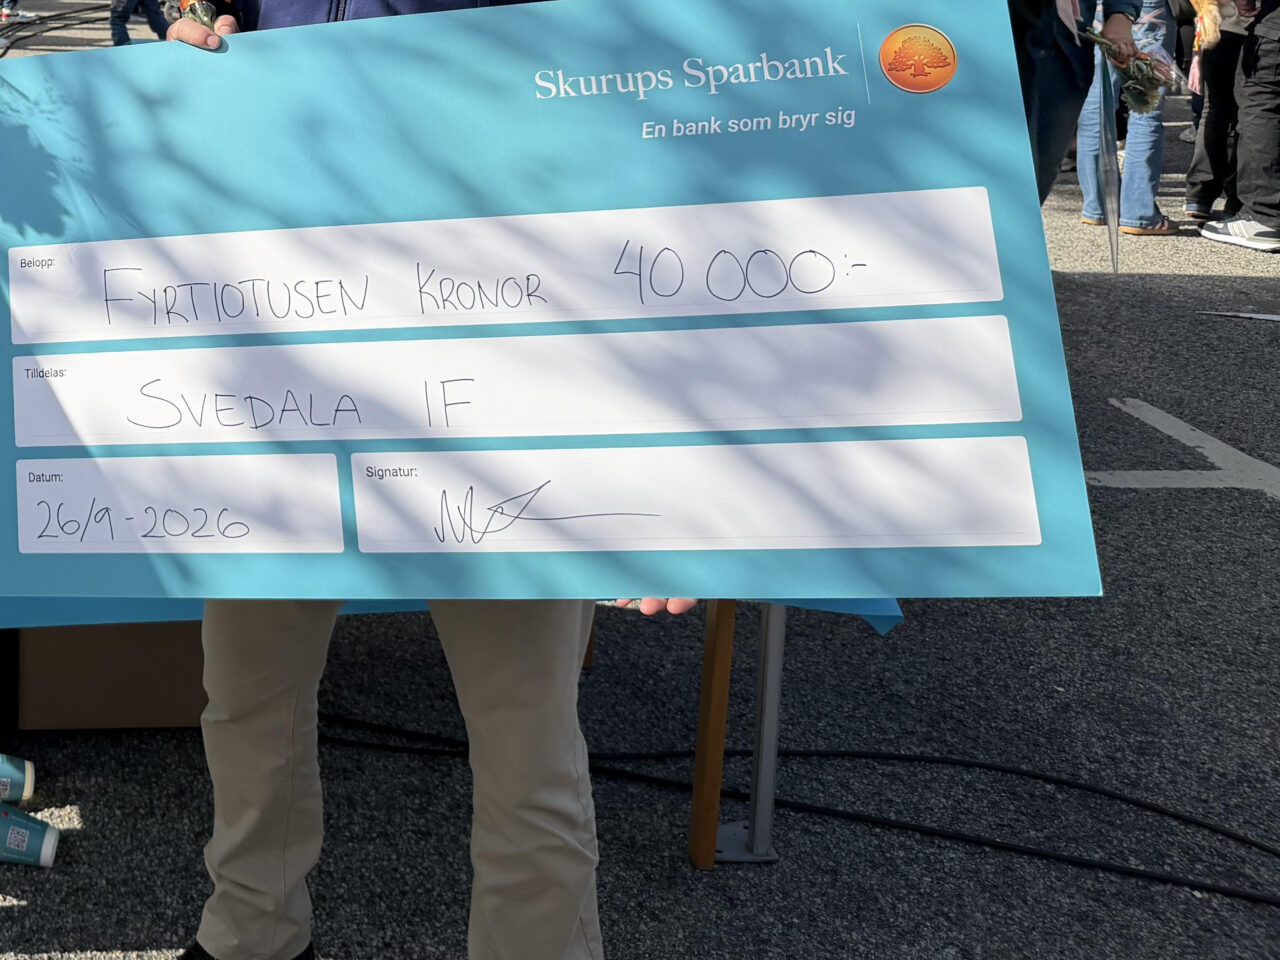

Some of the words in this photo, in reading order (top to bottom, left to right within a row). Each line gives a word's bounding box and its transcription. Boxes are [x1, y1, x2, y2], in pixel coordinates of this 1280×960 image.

[534, 67, 674, 101] Skurups
[681, 46, 848, 95] Sparbank
[641, 121, 666, 139] En
[672, 115, 722, 136] bank
[727, 116, 773, 133] som
[778, 110, 820, 132] bryr
[825, 106, 856, 129] sig
[19, 256, 56, 270] Belopp:
[103, 267, 369, 326] FYRTIOTUSEN
[416, 262, 548, 314] KRONOR
[24, 367, 67, 379] Tilldelas:
[126, 378, 362, 430] SVEDALA
[423, 378, 475, 429] IF
[28, 472, 64, 483] Datum:
[365, 466, 418, 480] Signatur:
